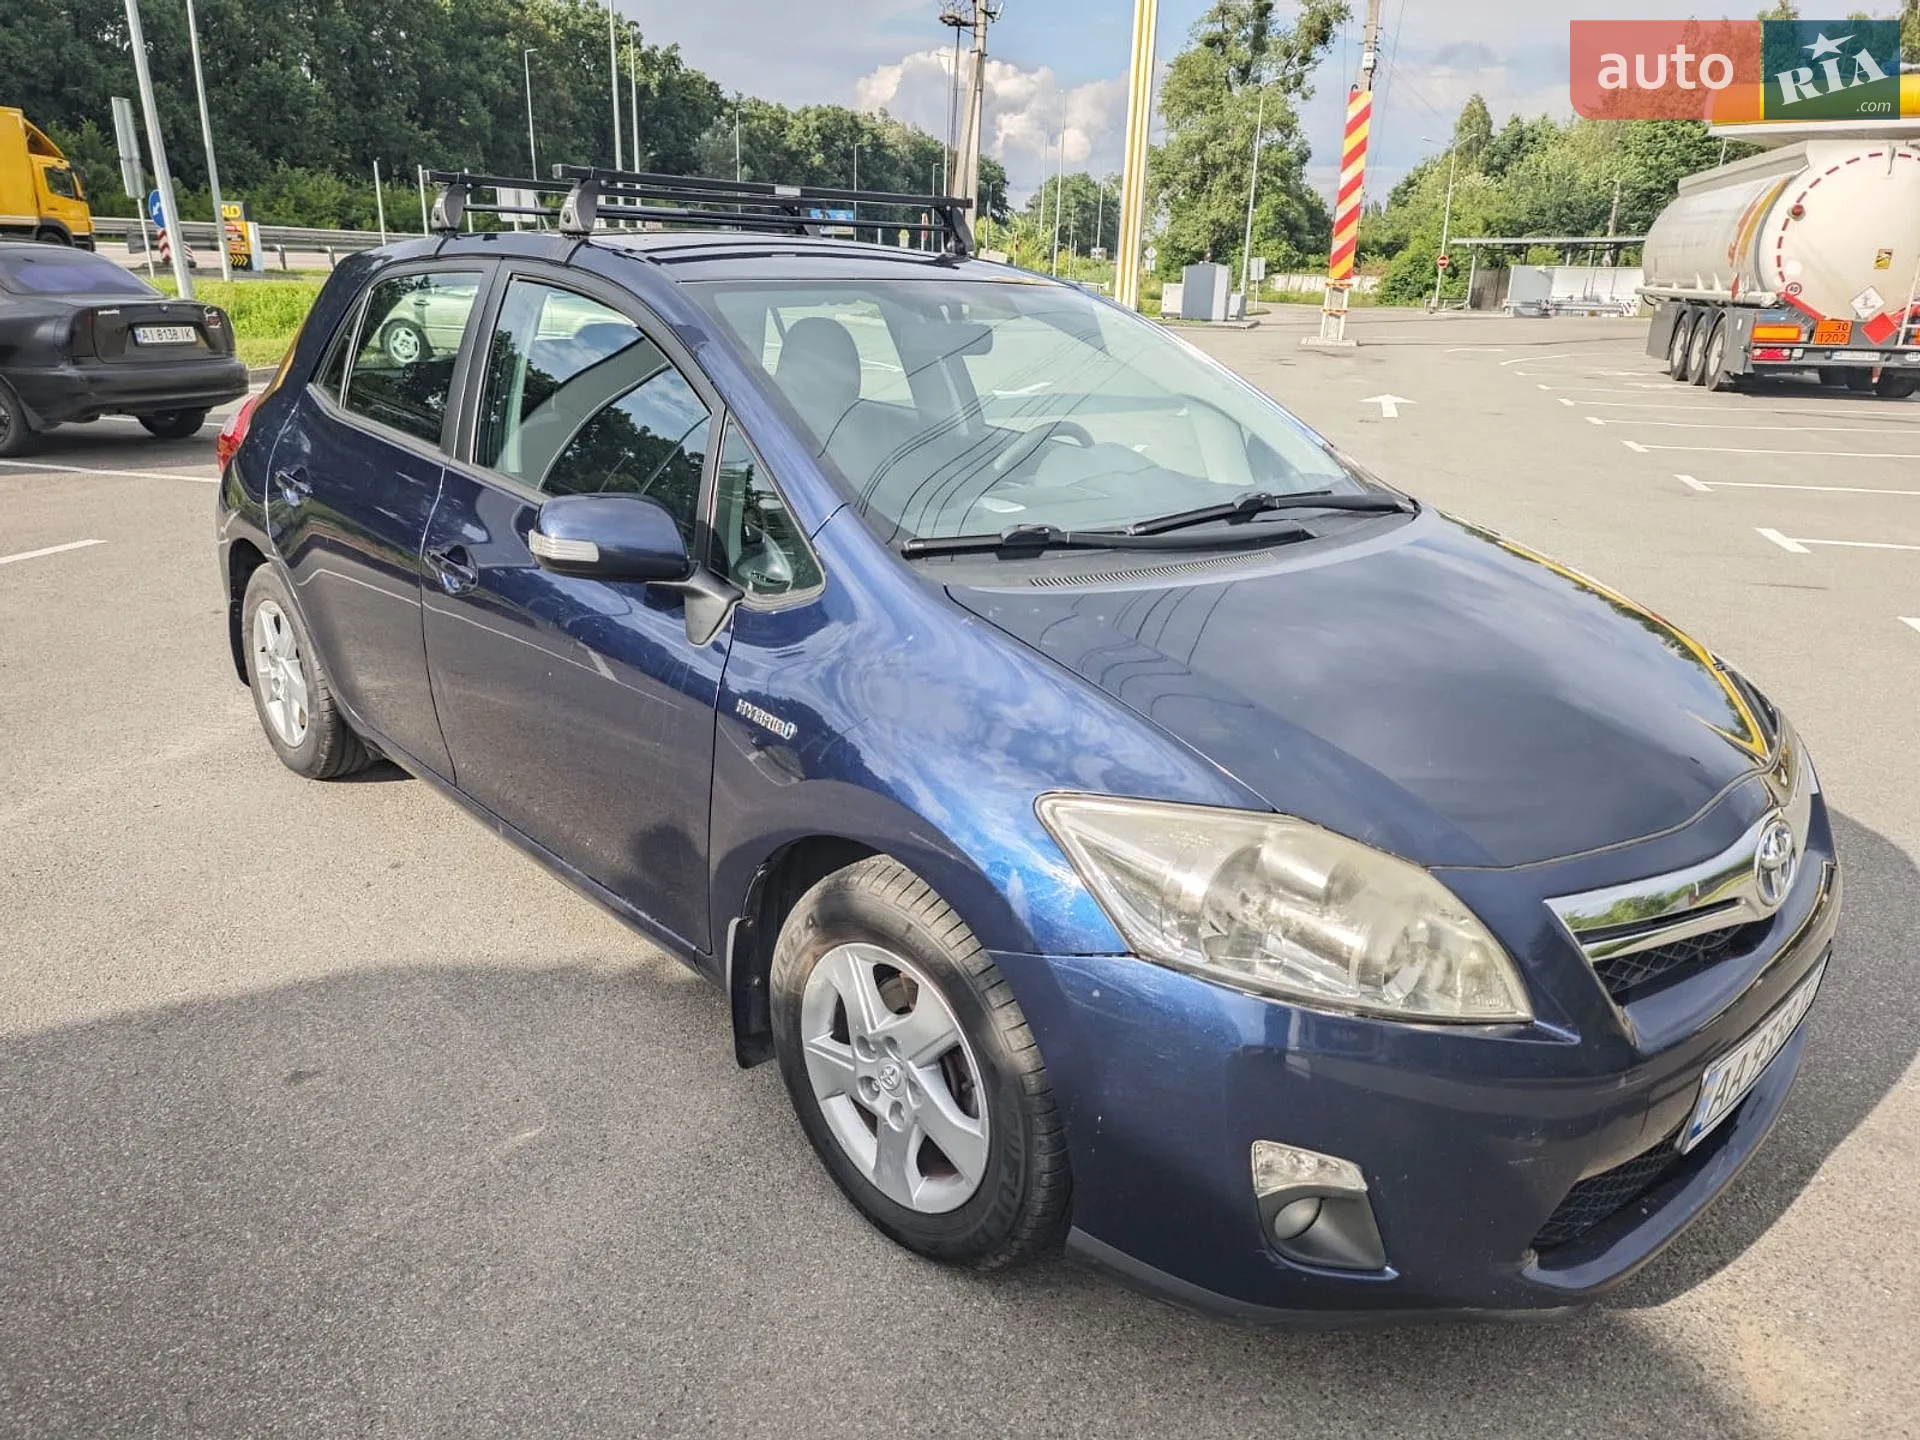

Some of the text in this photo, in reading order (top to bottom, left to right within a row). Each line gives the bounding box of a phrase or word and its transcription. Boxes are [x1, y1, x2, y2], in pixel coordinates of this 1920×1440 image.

[1835, 322, 1849, 331] 30
[1819, 333, 1847, 343] 1202
[736, 698, 797, 740] HYBRID
